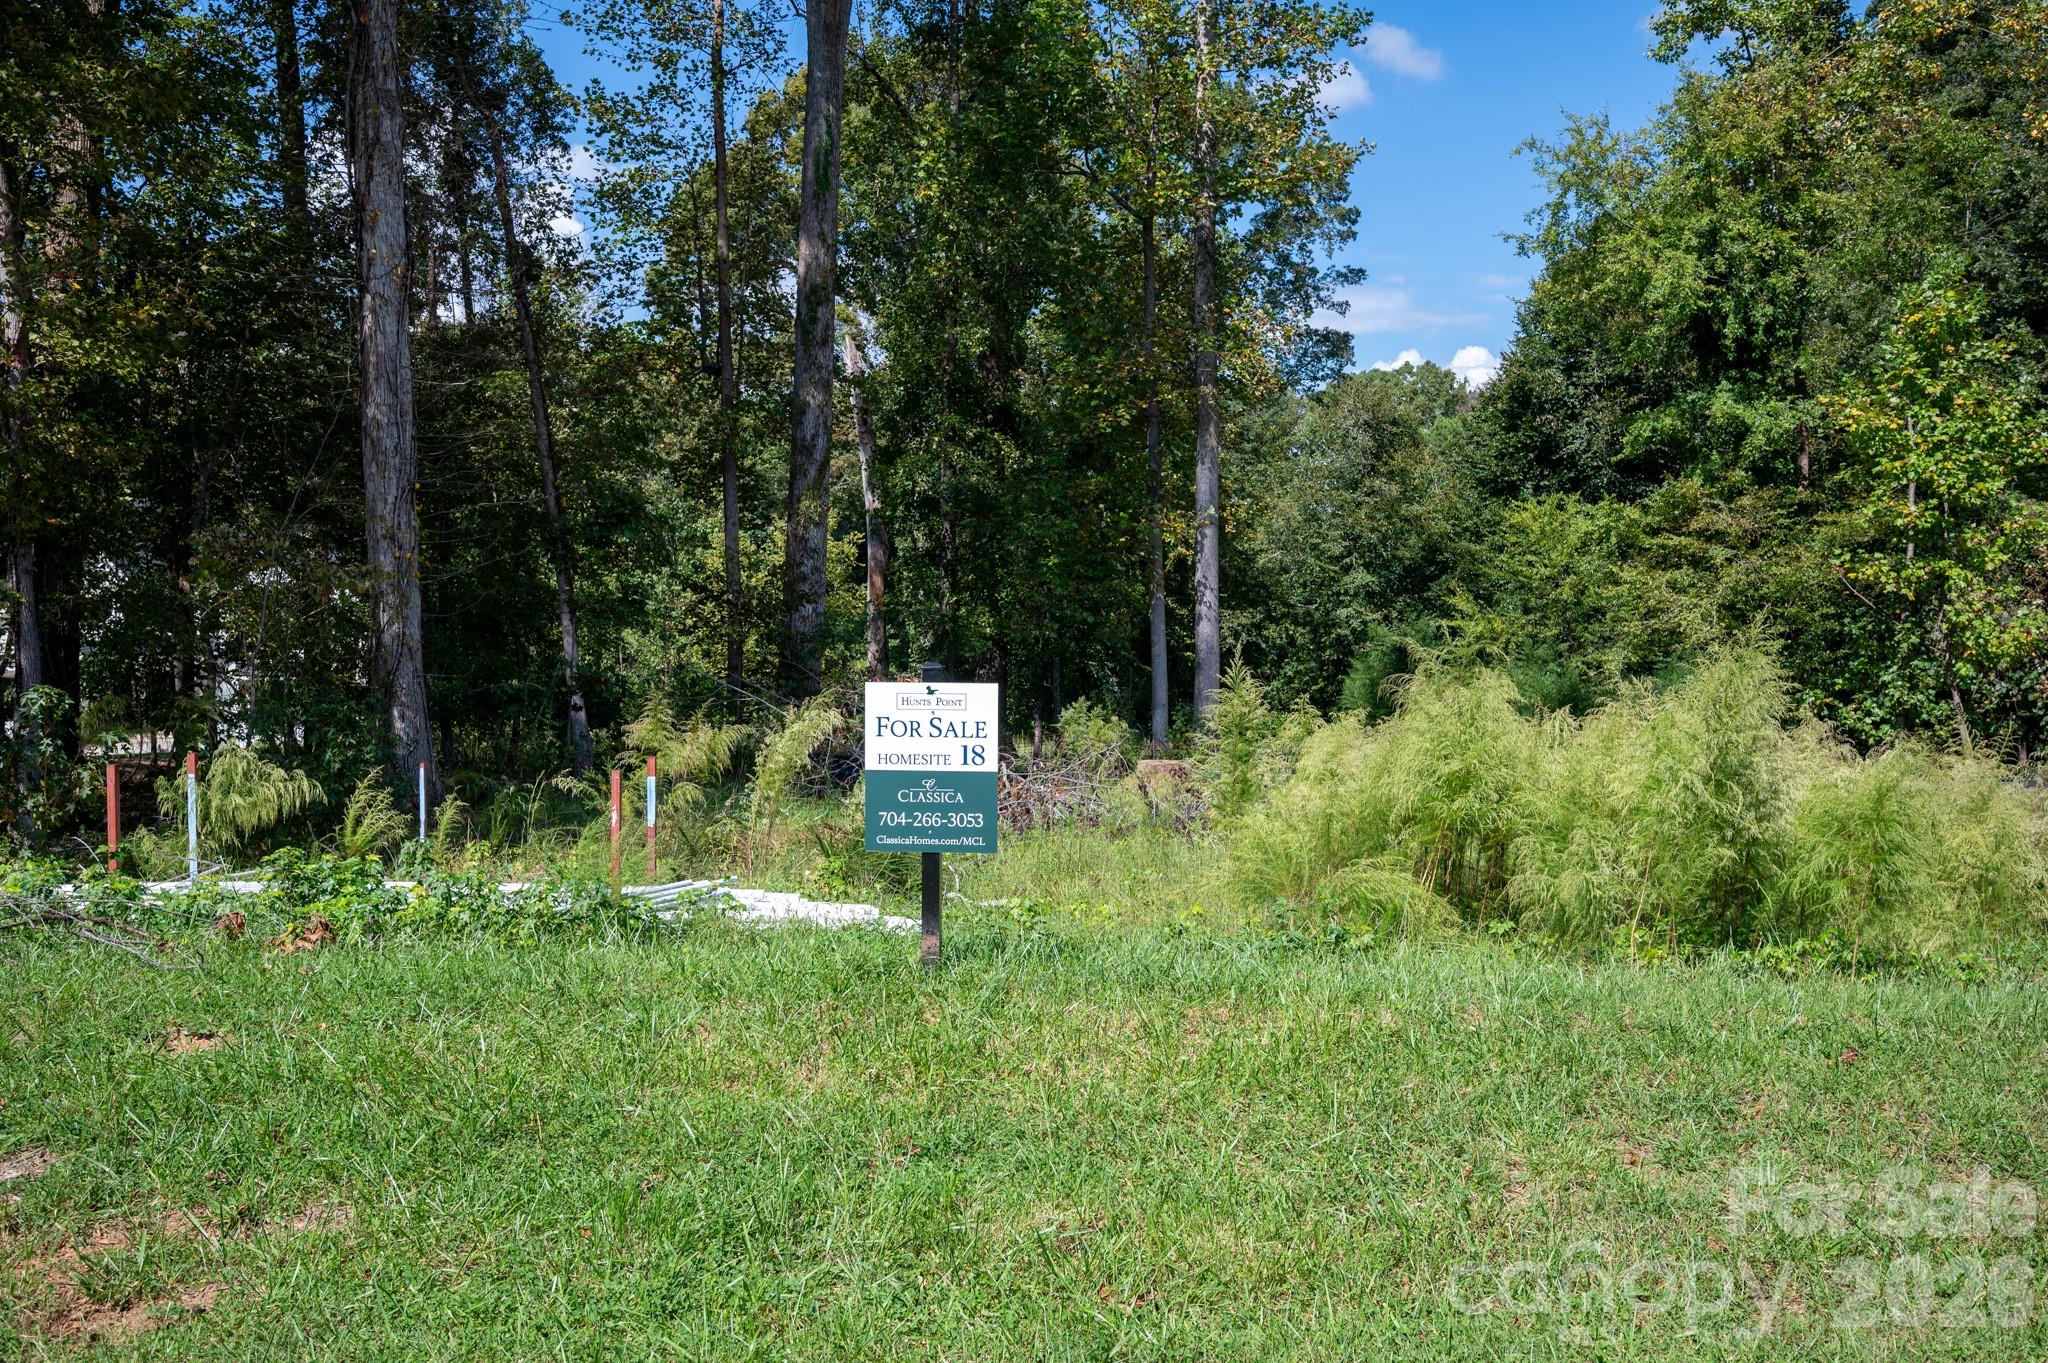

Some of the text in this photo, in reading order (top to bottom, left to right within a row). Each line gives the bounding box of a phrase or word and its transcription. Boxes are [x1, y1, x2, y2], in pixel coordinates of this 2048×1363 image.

[901, 696, 963, 707] HUNTS POINT
[876, 716, 987, 739] FOR SALE
[877, 744, 986, 766] HOMESITE 18
[897, 789, 964, 804] CLASSICA
[878, 811, 984, 828] 704-266-3053
[876, 835, 986, 846] ClassicaHomes.com/MCL
